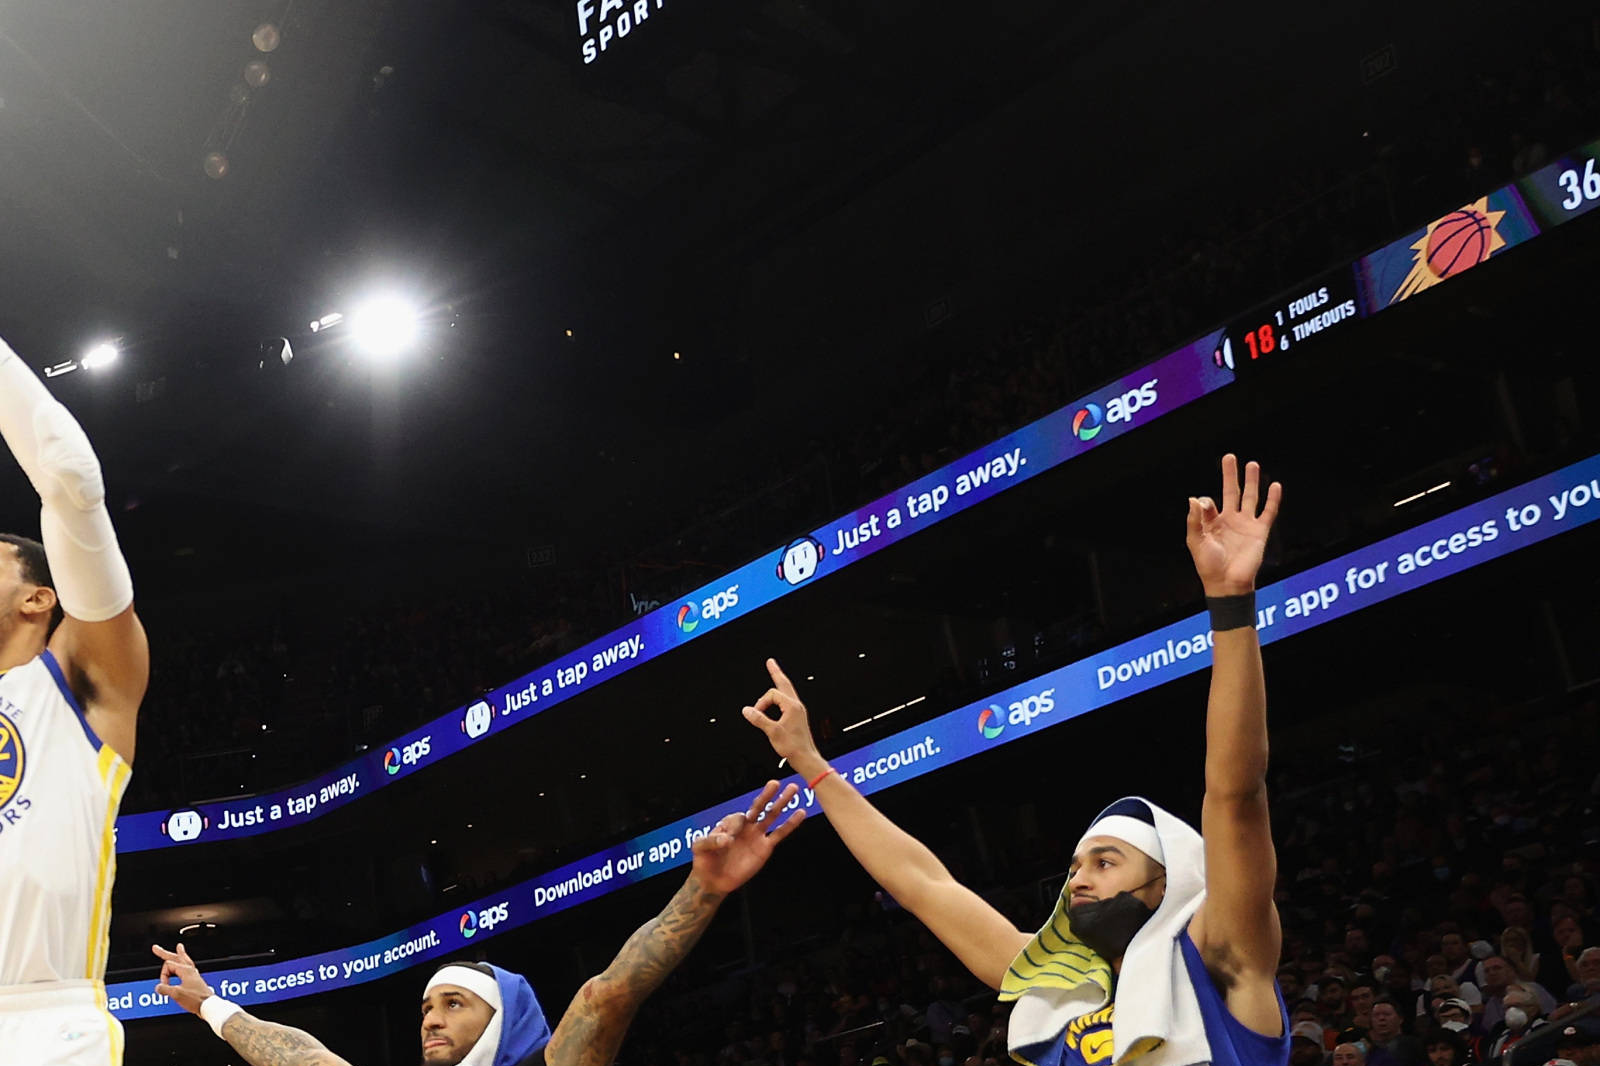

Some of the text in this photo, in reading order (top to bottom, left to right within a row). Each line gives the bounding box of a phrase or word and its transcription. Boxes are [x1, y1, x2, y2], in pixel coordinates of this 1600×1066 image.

[1275, 287, 1329, 326] 1 FOULS
[1280, 299, 1356, 351] 6 TIMEOUTS
[1244, 324, 1276, 360] 18
[1106, 378, 1158, 423] aps
[832, 447, 1027, 555] Just a tap away.
[1256, 605, 1277, 631] ur
[1285, 583, 1339, 618] app
[1345, 561, 1389, 594] for
[1397, 520, 1499, 574] access
[1505, 504, 1541, 531] to
[701, 584, 739, 619] aps
[501, 634, 645, 716] Just a tap away.
[1008, 688, 1055, 726] aps
[402, 735, 431, 765] aps
[217, 773, 360, 830] Just a tap away.
[534, 859, 613, 907] Download
[616, 851, 645, 875] our
[648, 838, 682, 863] app
[853, 736, 941, 784] account.
[478, 901, 509, 930] aps
[220, 979, 250, 997] for
[254, 969, 315, 993] access
[318, 964, 338, 981] to
[342, 953, 381, 979] your
[383, 930, 441, 964] account.
